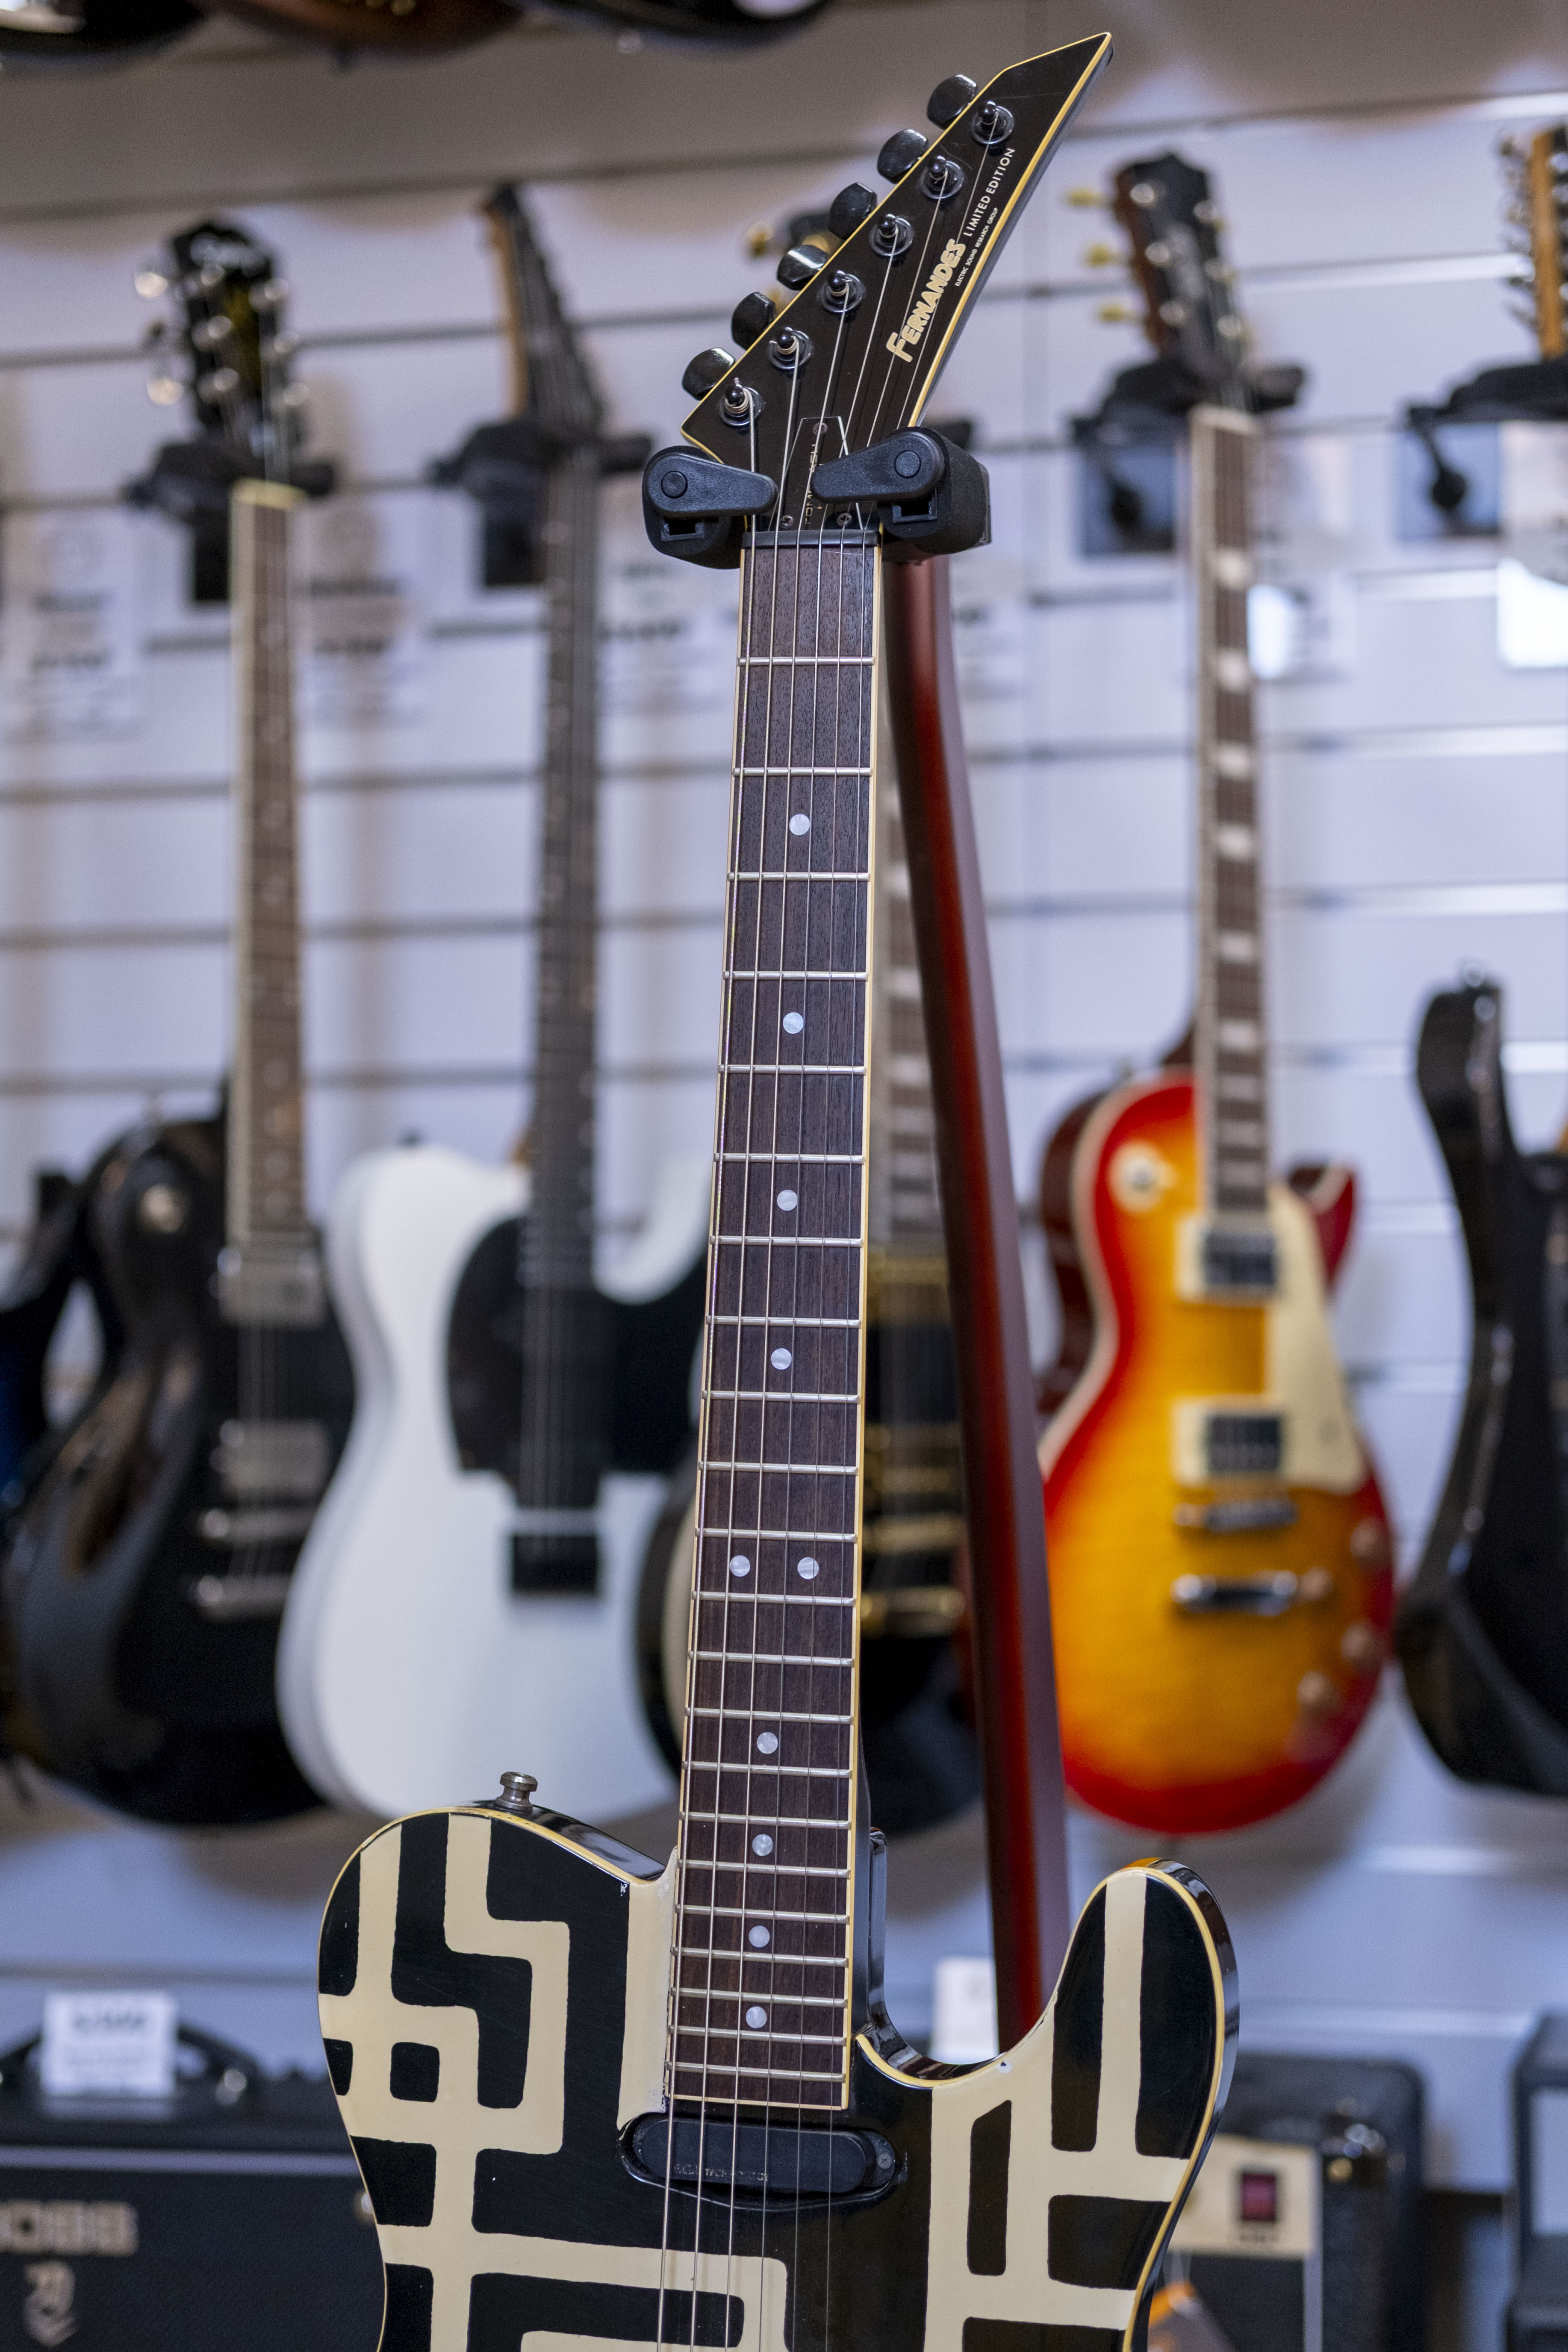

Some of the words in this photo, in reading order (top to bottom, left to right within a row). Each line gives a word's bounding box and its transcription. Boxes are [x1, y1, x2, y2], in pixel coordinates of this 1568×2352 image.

[886, 239, 966, 362] FERNANDES
[963, 195, 990, 237] LIMITED
[986, 148, 1015, 194] EDITION
[955, 266, 969, 286] ELECTRIC
[965, 249, 978, 266] SOUND
[975, 225, 990, 248] RESEARCH
[987, 207, 999, 224] GROUP
